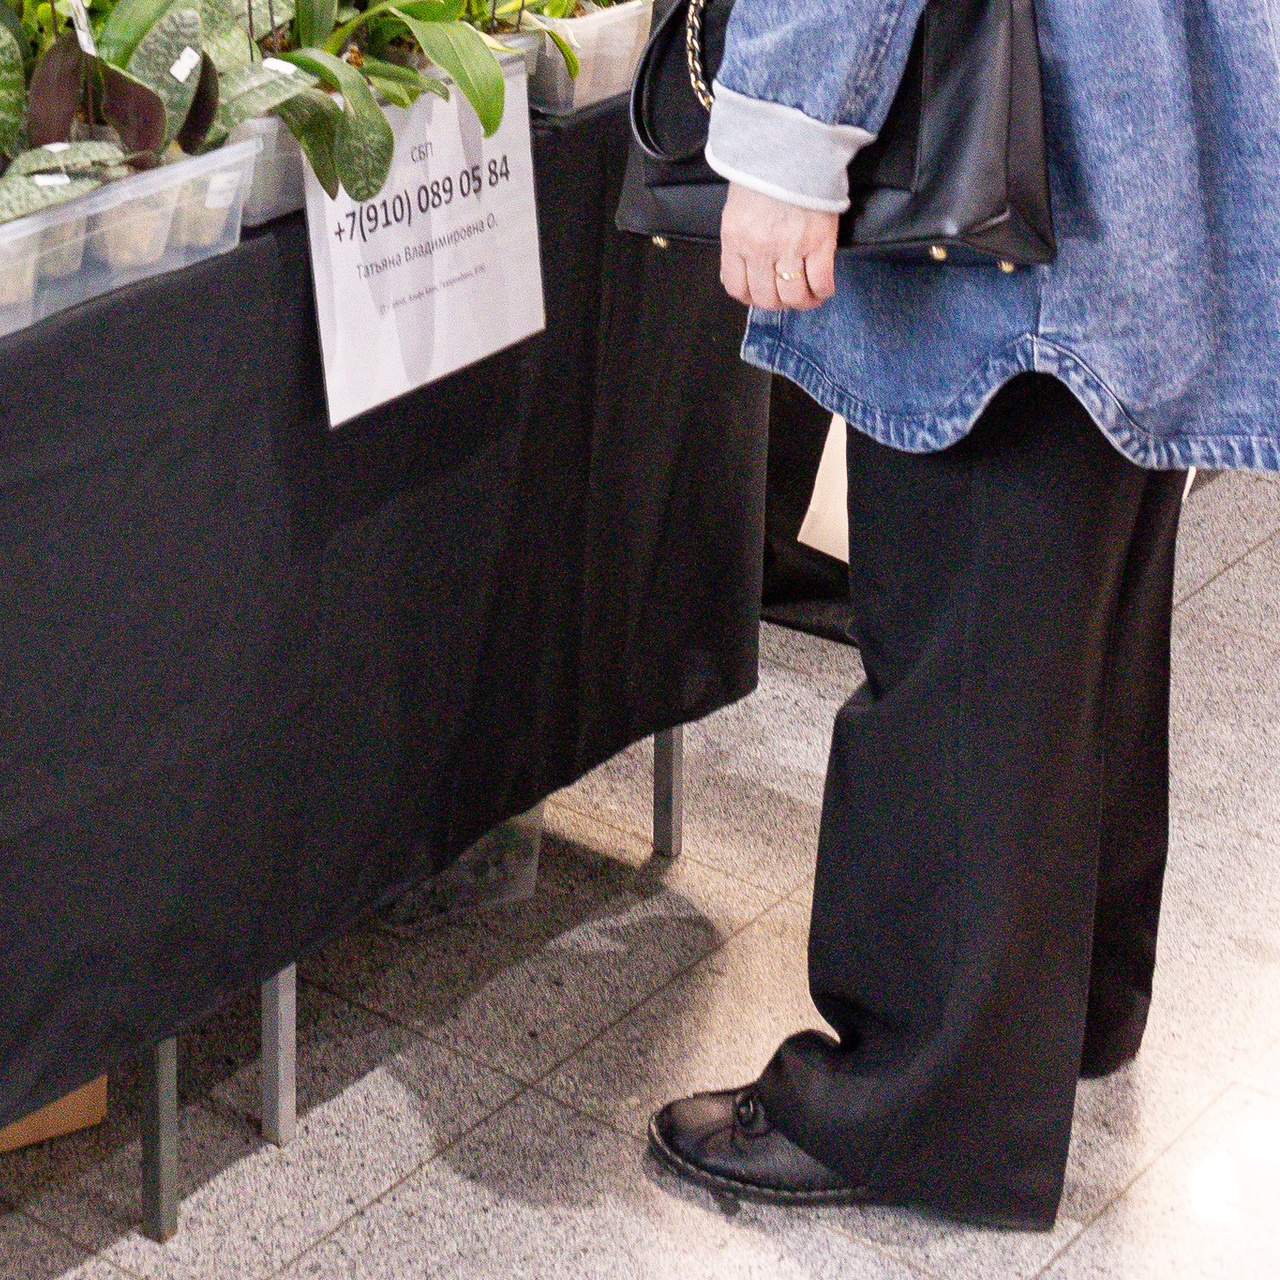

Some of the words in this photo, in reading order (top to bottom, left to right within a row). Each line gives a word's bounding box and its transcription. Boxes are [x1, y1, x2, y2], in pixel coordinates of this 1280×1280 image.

[410, 141, 434, 164] СБП
[334, 189, 413, 243] +7(910)
[417, 175, 453, 214] 089
[458, 164, 483, 198] 05
[487, 153, 511, 188] 84
[356, 252, 402, 280] Татьяна
[403, 219, 485, 264] Владимировна
